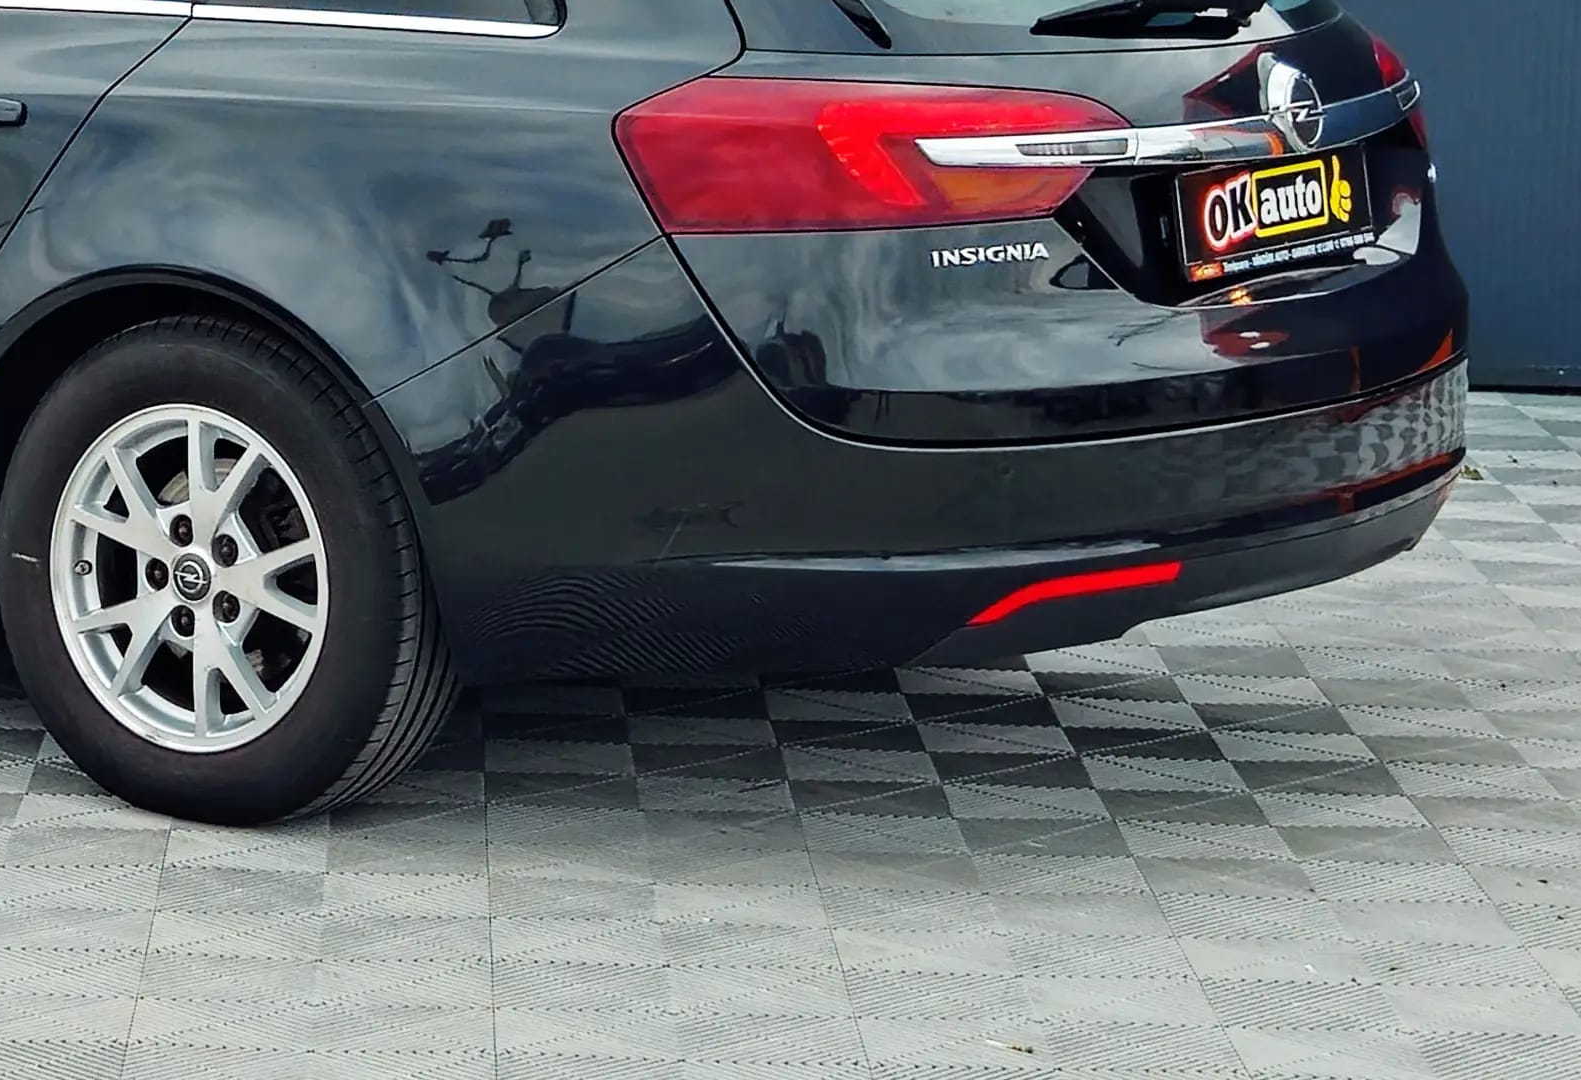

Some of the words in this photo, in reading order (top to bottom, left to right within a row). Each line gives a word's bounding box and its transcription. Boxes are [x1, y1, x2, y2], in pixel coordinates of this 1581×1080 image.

[1206, 174, 1254, 250] OK
[1260, 173, 1322, 225] auto
[931, 242, 1050, 268] INSIGNIA
